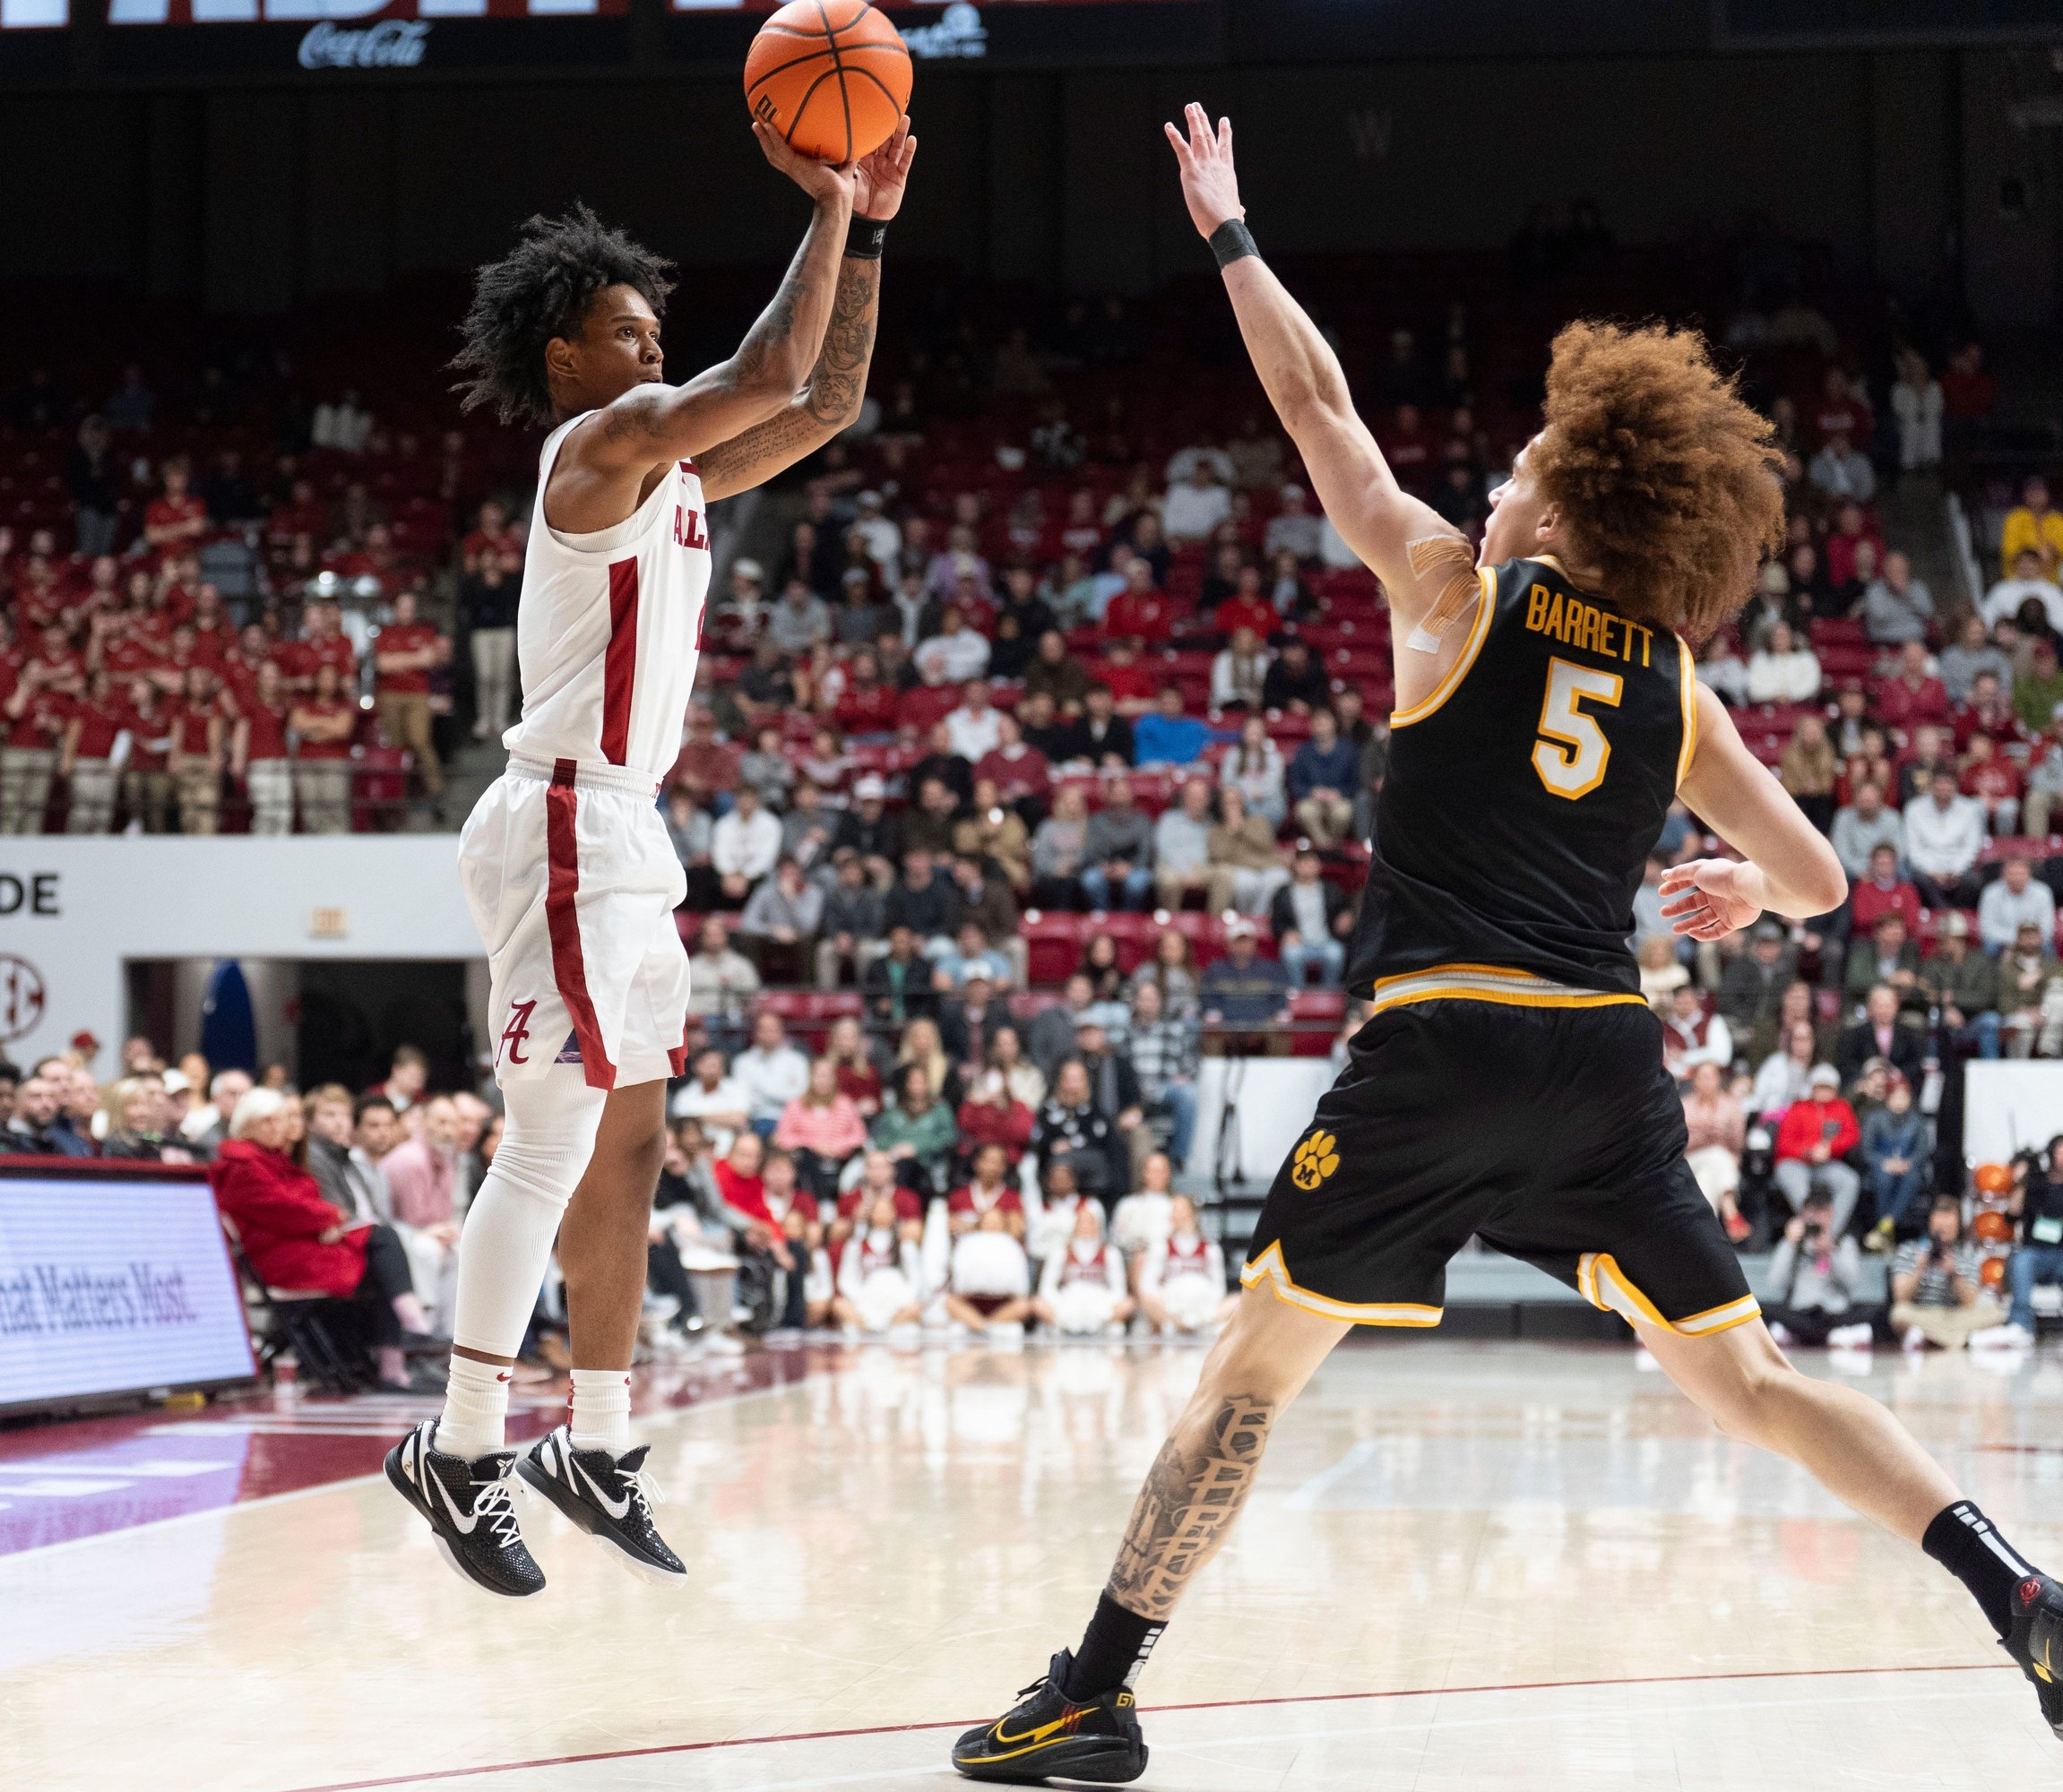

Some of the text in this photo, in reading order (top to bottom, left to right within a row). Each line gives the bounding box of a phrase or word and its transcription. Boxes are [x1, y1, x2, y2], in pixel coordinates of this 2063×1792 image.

[674, 504, 709, 552] AL
[1525, 583, 1653, 668] BARRETT
[1531, 656, 1624, 800] 5
[496, 999, 538, 1068] A
[1296, 1163, 1316, 1186] M
